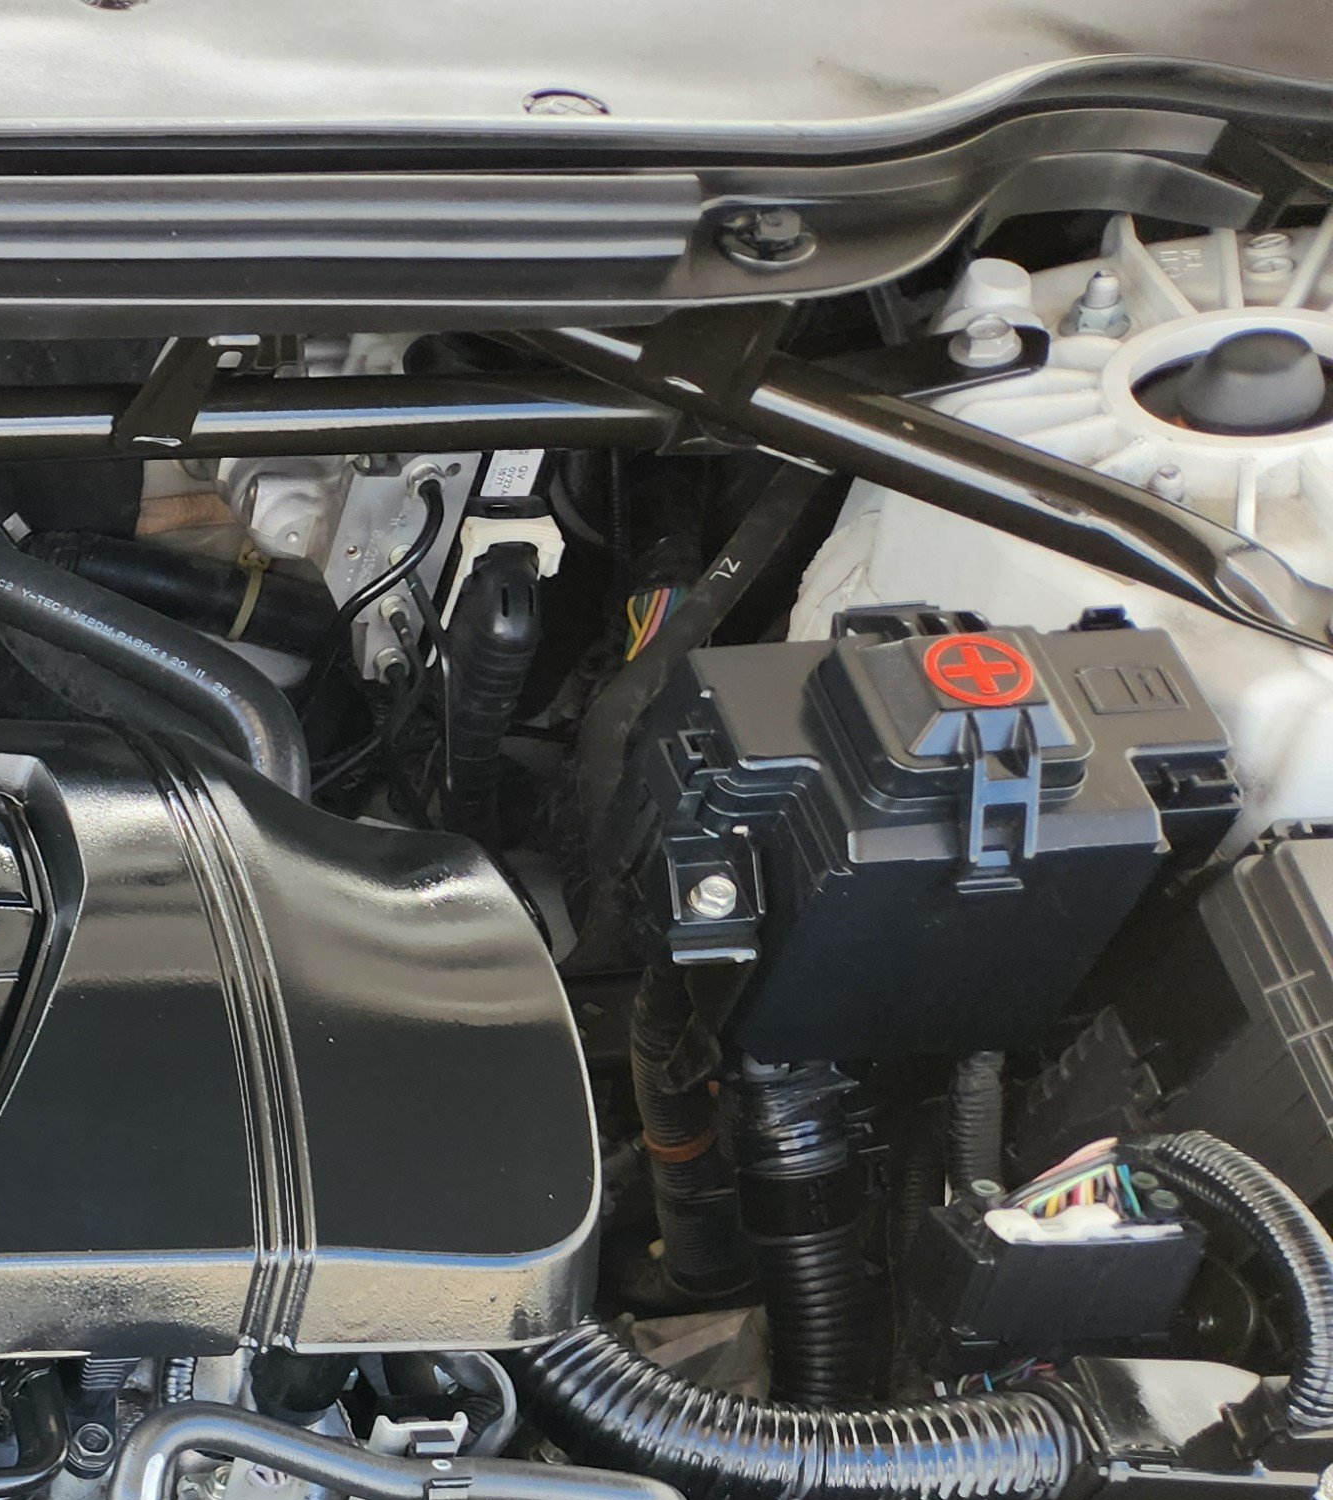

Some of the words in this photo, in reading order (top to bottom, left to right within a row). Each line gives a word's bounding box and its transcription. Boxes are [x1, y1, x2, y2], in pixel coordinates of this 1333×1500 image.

[21, 588, 63, 613] Y-TEC
[168, 656, 188, 670] 20
[211, 681, 232, 699] 25
